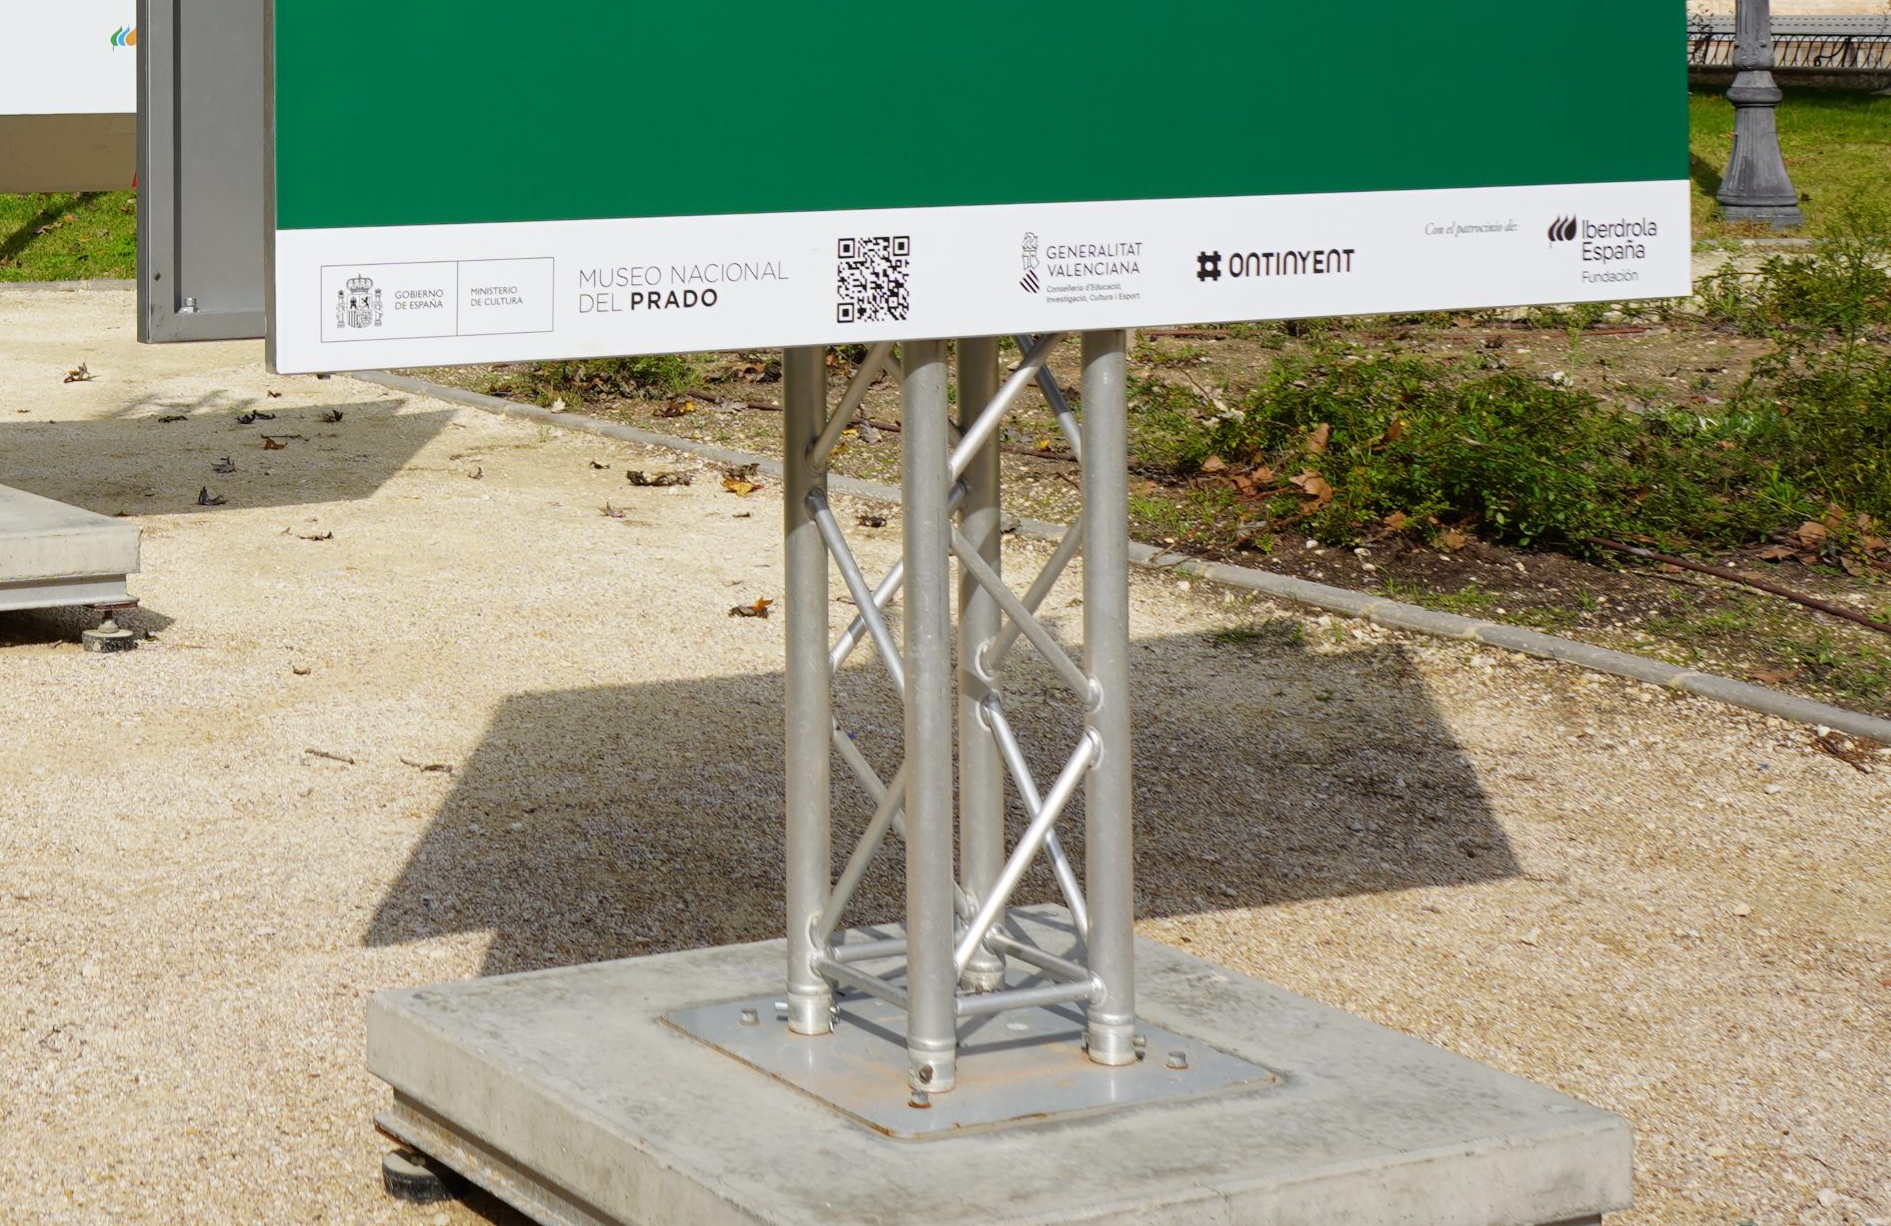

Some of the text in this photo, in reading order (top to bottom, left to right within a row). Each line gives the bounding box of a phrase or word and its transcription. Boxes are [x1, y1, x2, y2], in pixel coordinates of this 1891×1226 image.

[1425, 223, 1444, 235] Con
[1446, 222, 1455, 234] el
[1455, 222, 1502, 237] patrocinio
[1582, 218, 1657, 239] Iberdrola
[1046, 242, 1142, 259] GENERALITAT
[1582, 240, 1645, 264] España
[1047, 262, 1140, 277] VALENCIANA
[1229, 249, 1355, 277] ONTINYENT
[580, 261, 789, 288] MUSEO NACIONAL
[1582, 270, 1638, 283] Fundación
[395, 290, 443, 299] GOBIERNO
[471, 286, 517, 295] MINISTERIO
[395, 298, 443, 310] DE ESPAÑA
[471, 297, 523, 306] DE CULTURA
[579, 289, 718, 313] DEL PRADO
